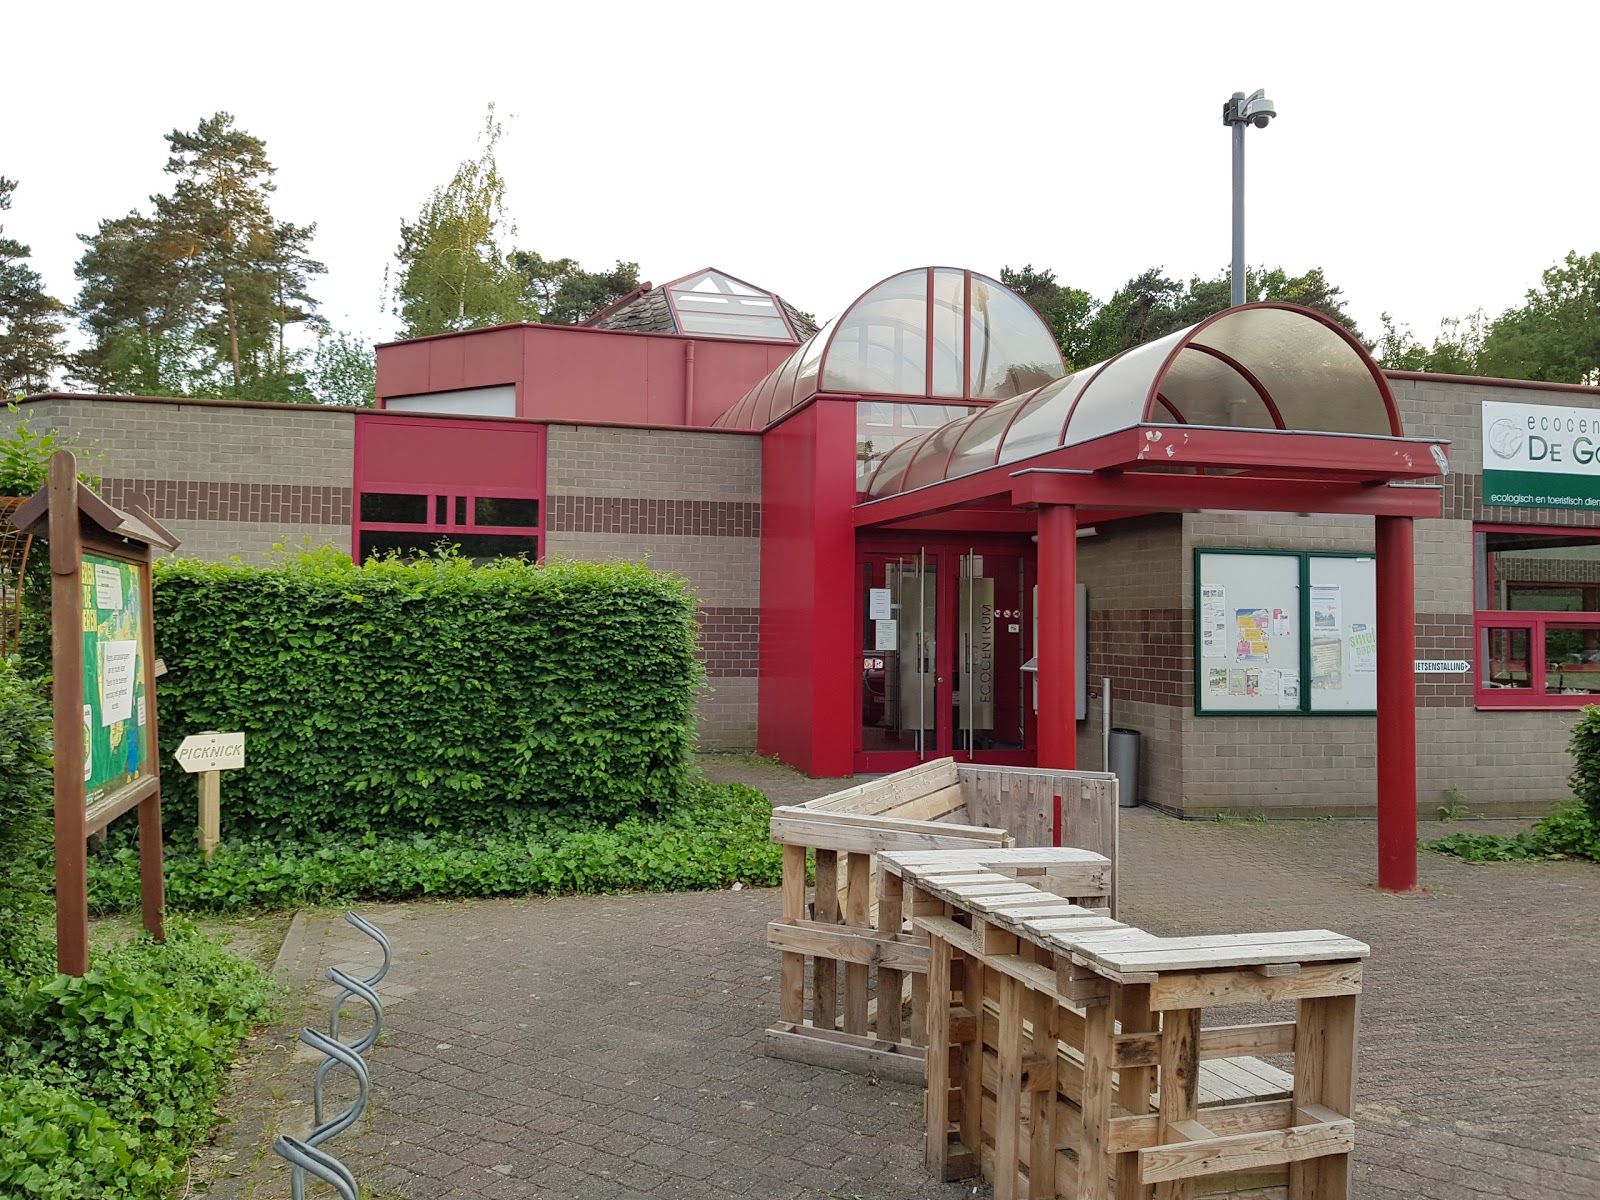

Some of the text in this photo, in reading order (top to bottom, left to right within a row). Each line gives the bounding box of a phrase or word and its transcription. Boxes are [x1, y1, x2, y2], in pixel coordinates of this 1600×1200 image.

[1527, 415, 1600, 434] ecocen
[1528, 435, 1600, 465] DE G
[1490, 493, 1534, 505] ecologisch
[1535, 496, 1546, 504] en
[1547, 495, 1583, 505] toeristisch
[980, 604, 992, 703] ECOCENTRUM
[179, 744, 242, 761] PICKNICK
